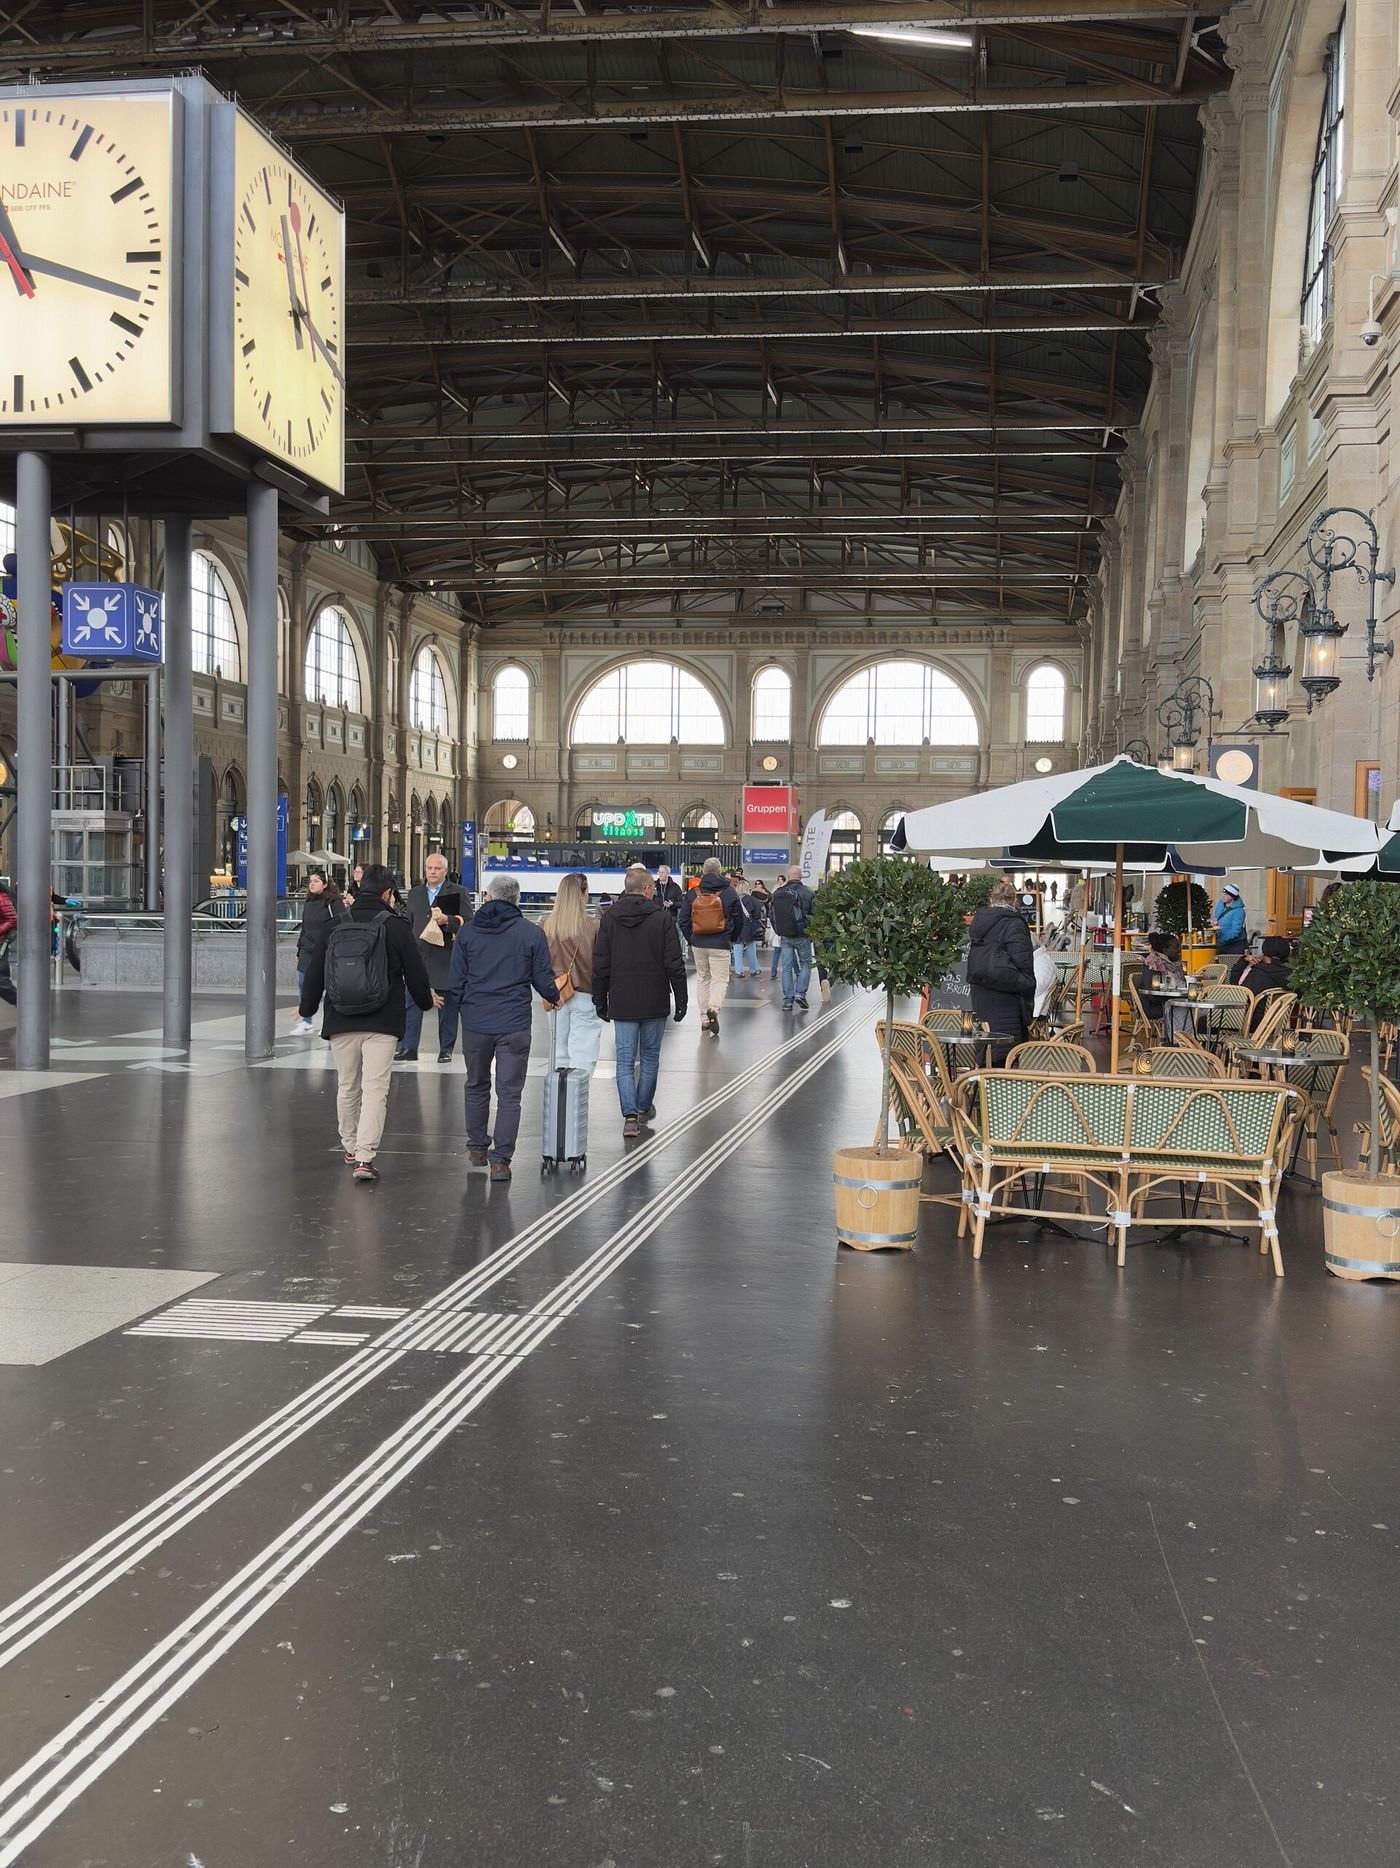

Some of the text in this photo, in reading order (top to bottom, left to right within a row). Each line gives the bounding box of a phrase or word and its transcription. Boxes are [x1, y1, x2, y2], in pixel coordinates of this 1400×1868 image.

[1, 181, 72, 200] NDAINE
[747, 804, 787, 814] Gruppen
[603, 825, 645, 837] fitness
